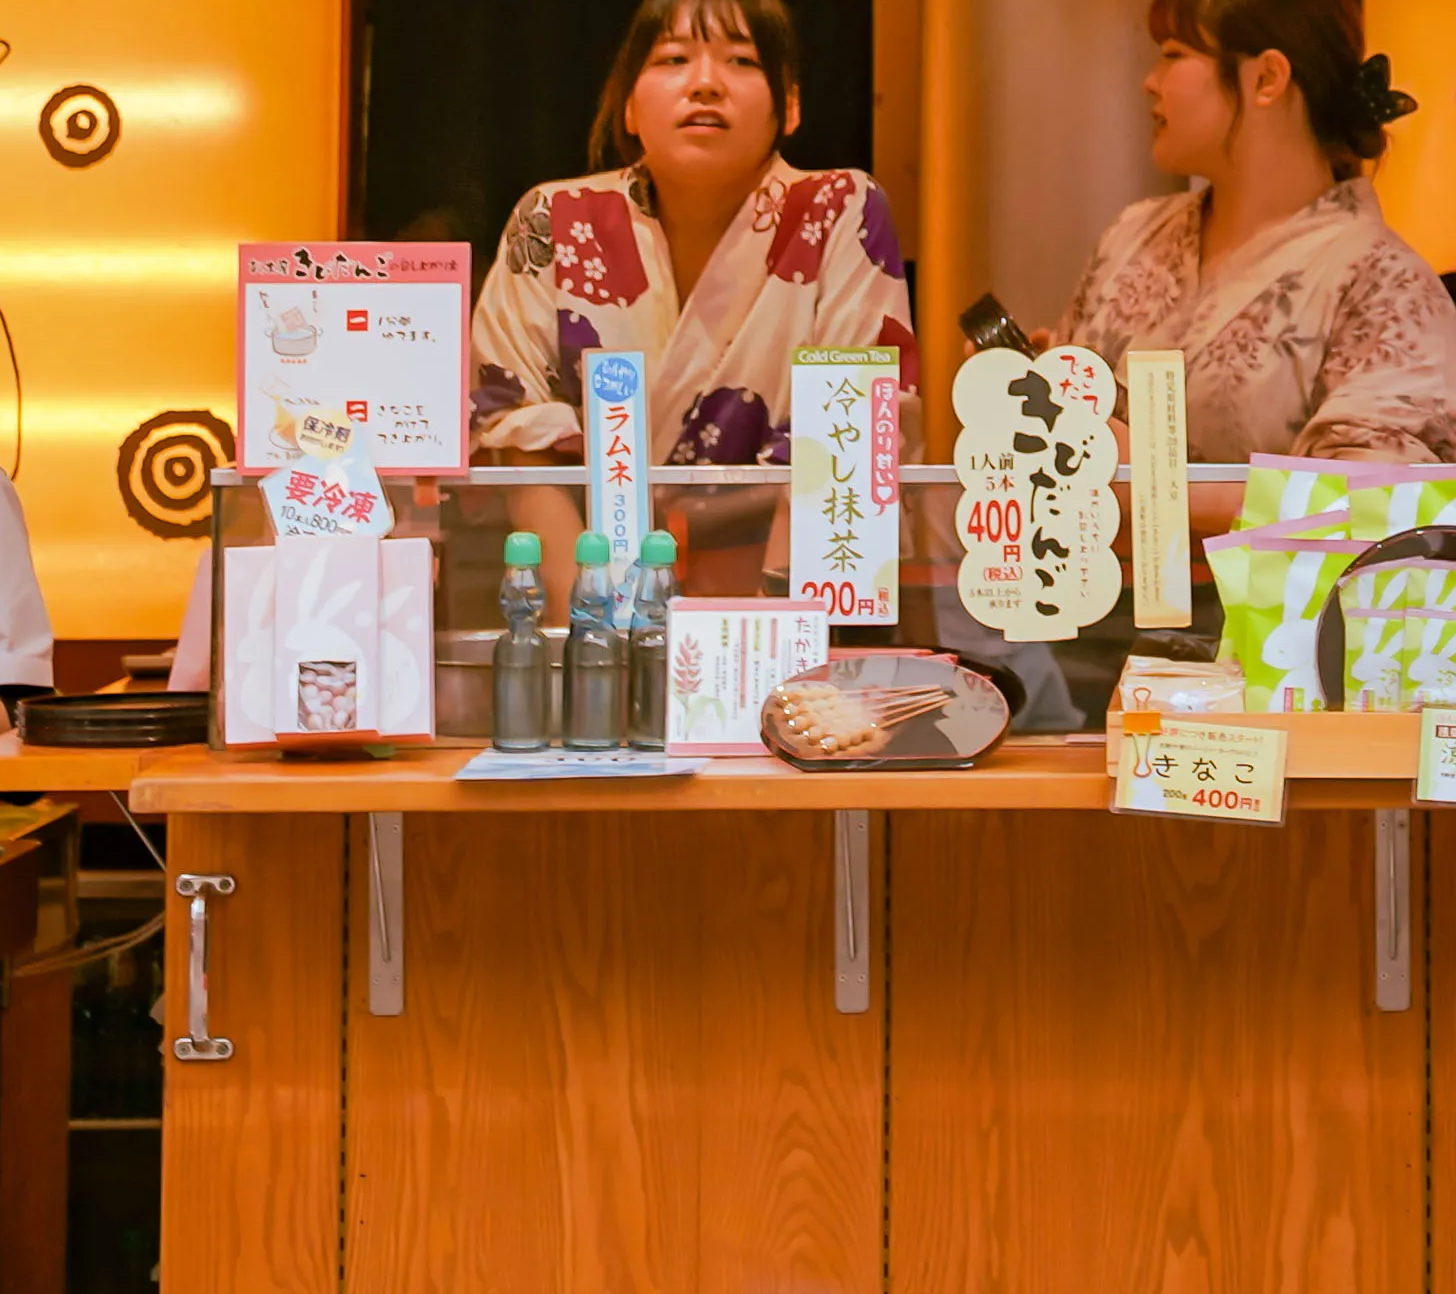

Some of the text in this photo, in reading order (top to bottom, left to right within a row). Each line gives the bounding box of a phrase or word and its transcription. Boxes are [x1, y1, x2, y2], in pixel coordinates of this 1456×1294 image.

[797, 350, 891, 363] Cold Green Tea
[605, 405, 633, 487] ラムネ
[876, 382, 895, 484] ほんのり甘い
[822, 377, 865, 572] 冷やし抹茶
[970, 452, 1015, 470] 1人前
[285, 470, 378, 524] 要冷凍
[985, 474, 1015, 492] 5本
[1008, 369, 1095, 617] きびだんご
[612, 494, 628, 553] 300円
[967, 499, 1022, 543] 400
[1003, 544, 1021, 563] 円
[983, 566, 1023, 581] (税込)
[1152, 754, 1255, 784] きなこ
[1192, 788, 1253, 810] 400円
